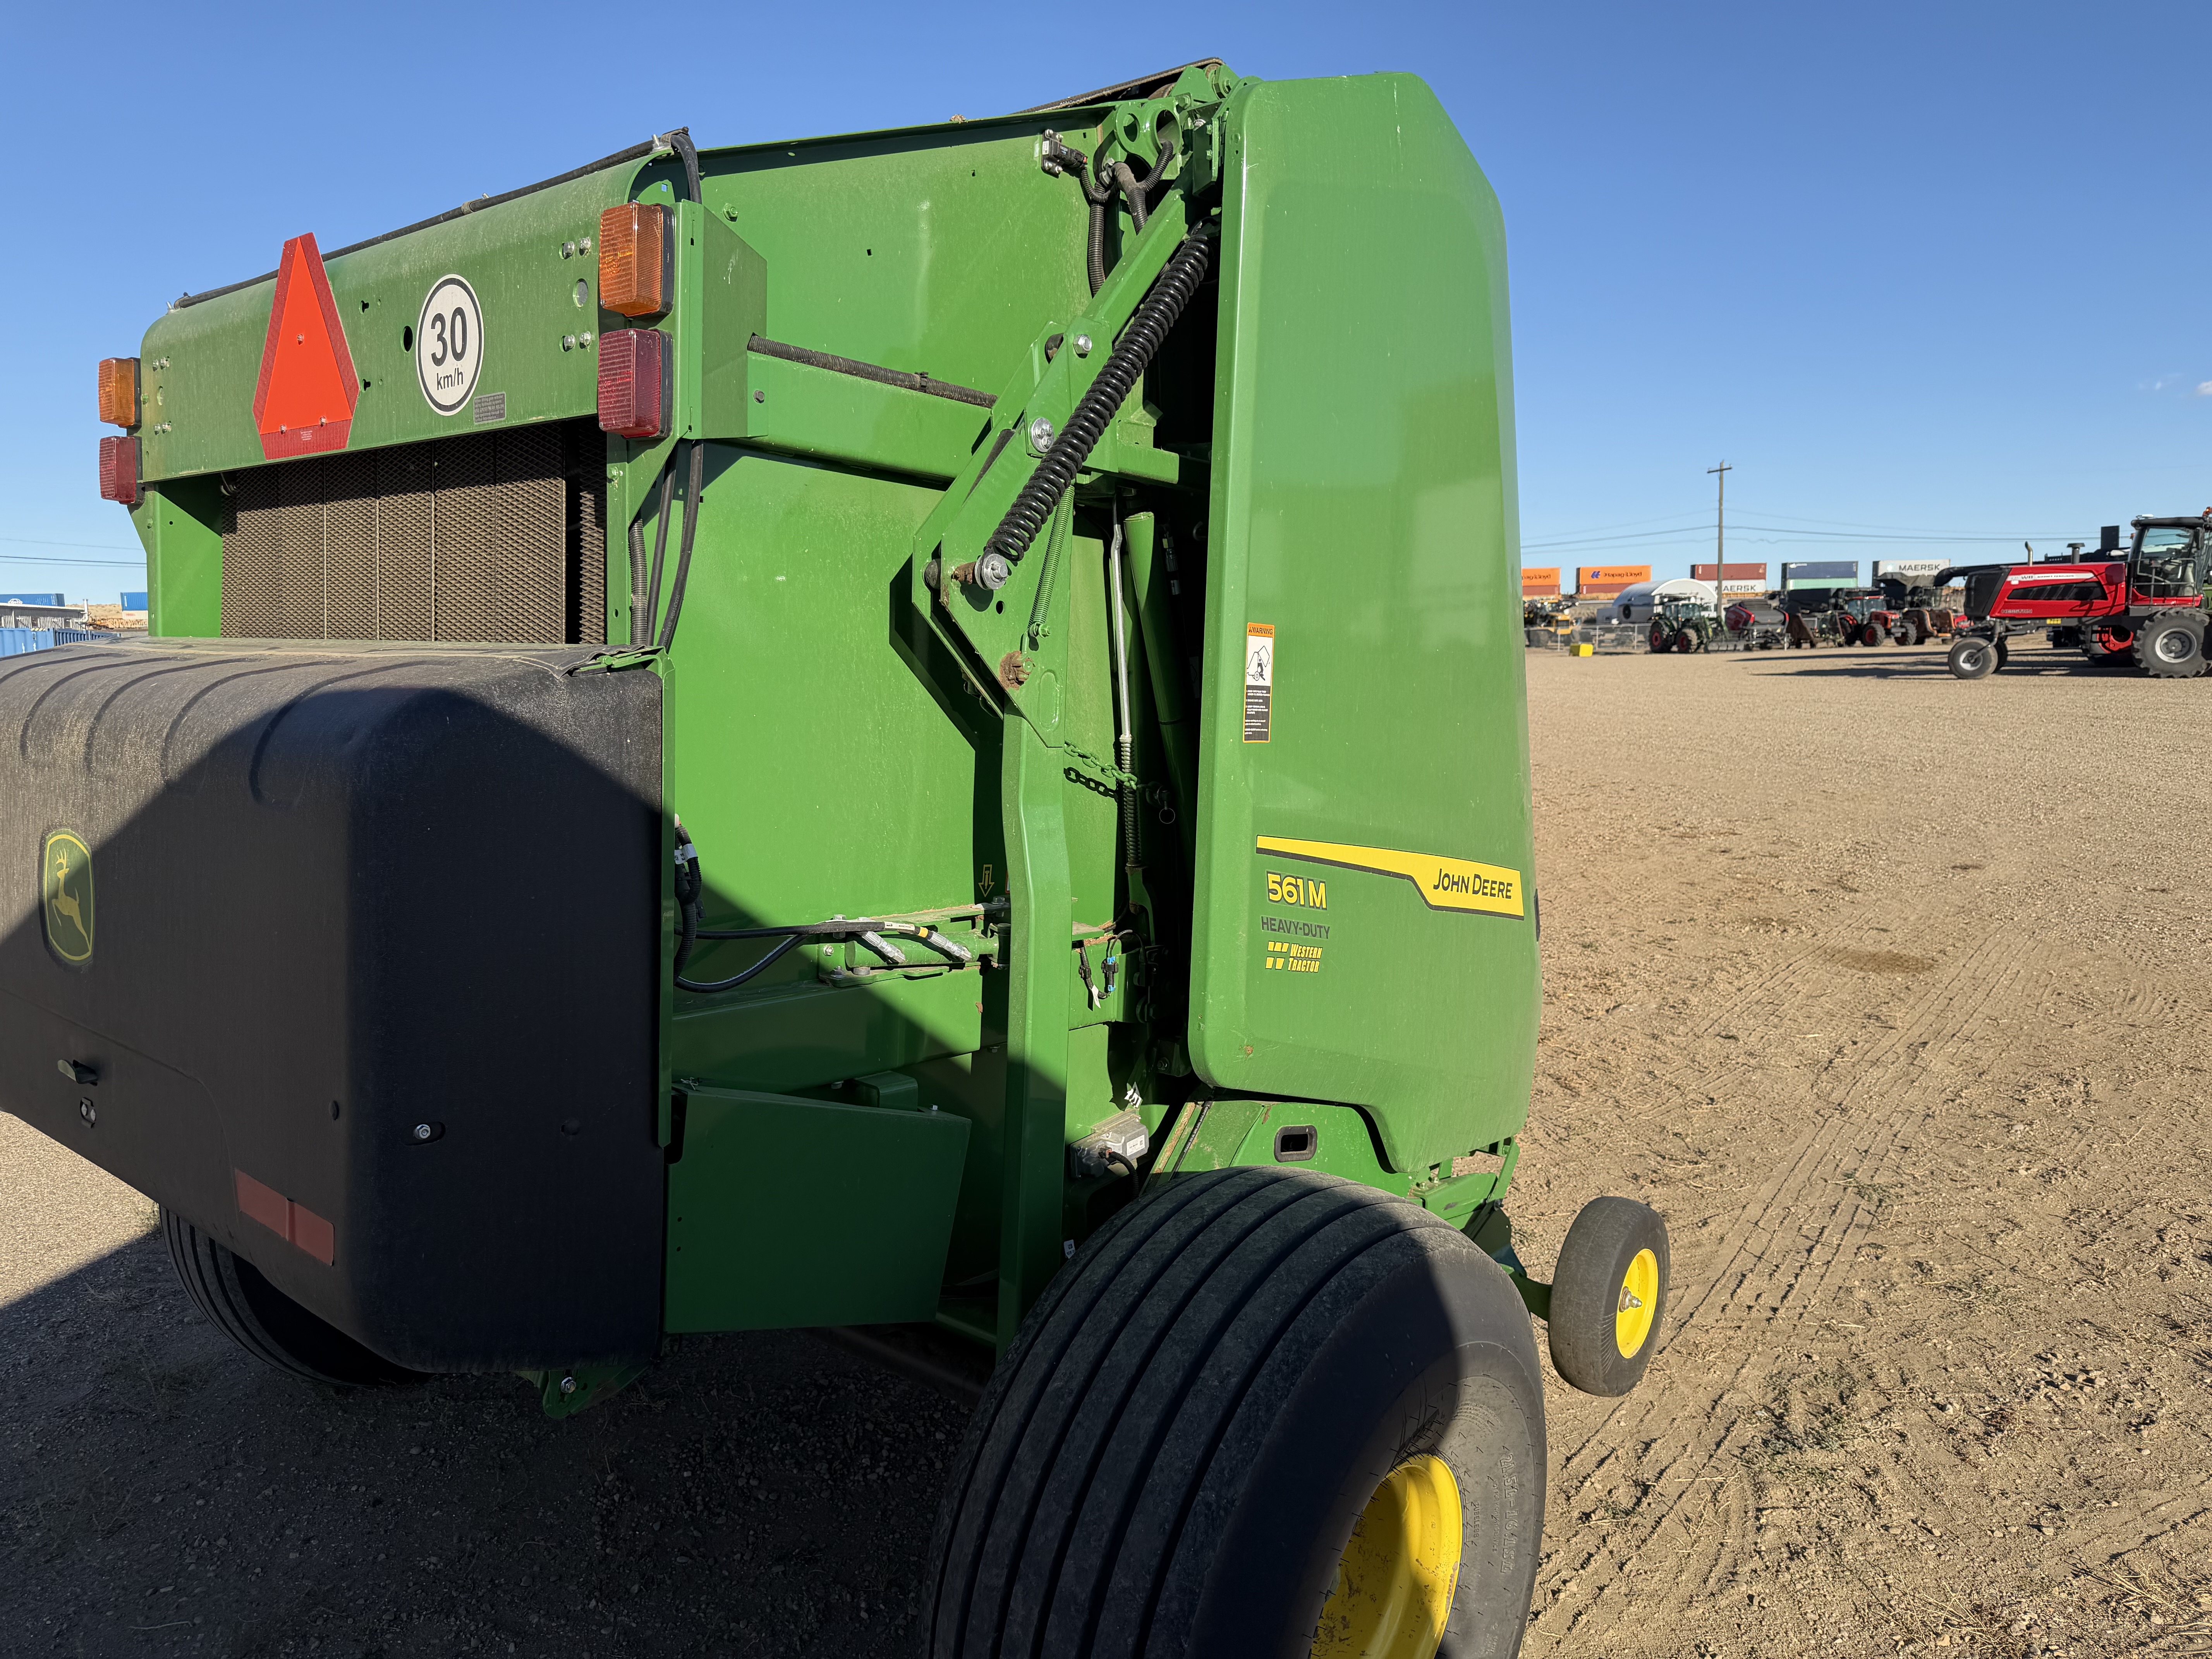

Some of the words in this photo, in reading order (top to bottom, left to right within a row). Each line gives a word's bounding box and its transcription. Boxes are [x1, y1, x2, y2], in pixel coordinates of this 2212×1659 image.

[431, 306, 467, 367] 30
[436, 367, 464, 390] km/h
[1252, 627, 1273, 635] WARNING
[1433, 868, 1470, 893] JOHN
[1472, 874, 1513, 899] DEERE
[1261, 916, 1330, 939] HEAVY-DUTY
[1290, 943, 1323, 959] WESTERN
[1288, 957, 1320, 973] TRACTOR
